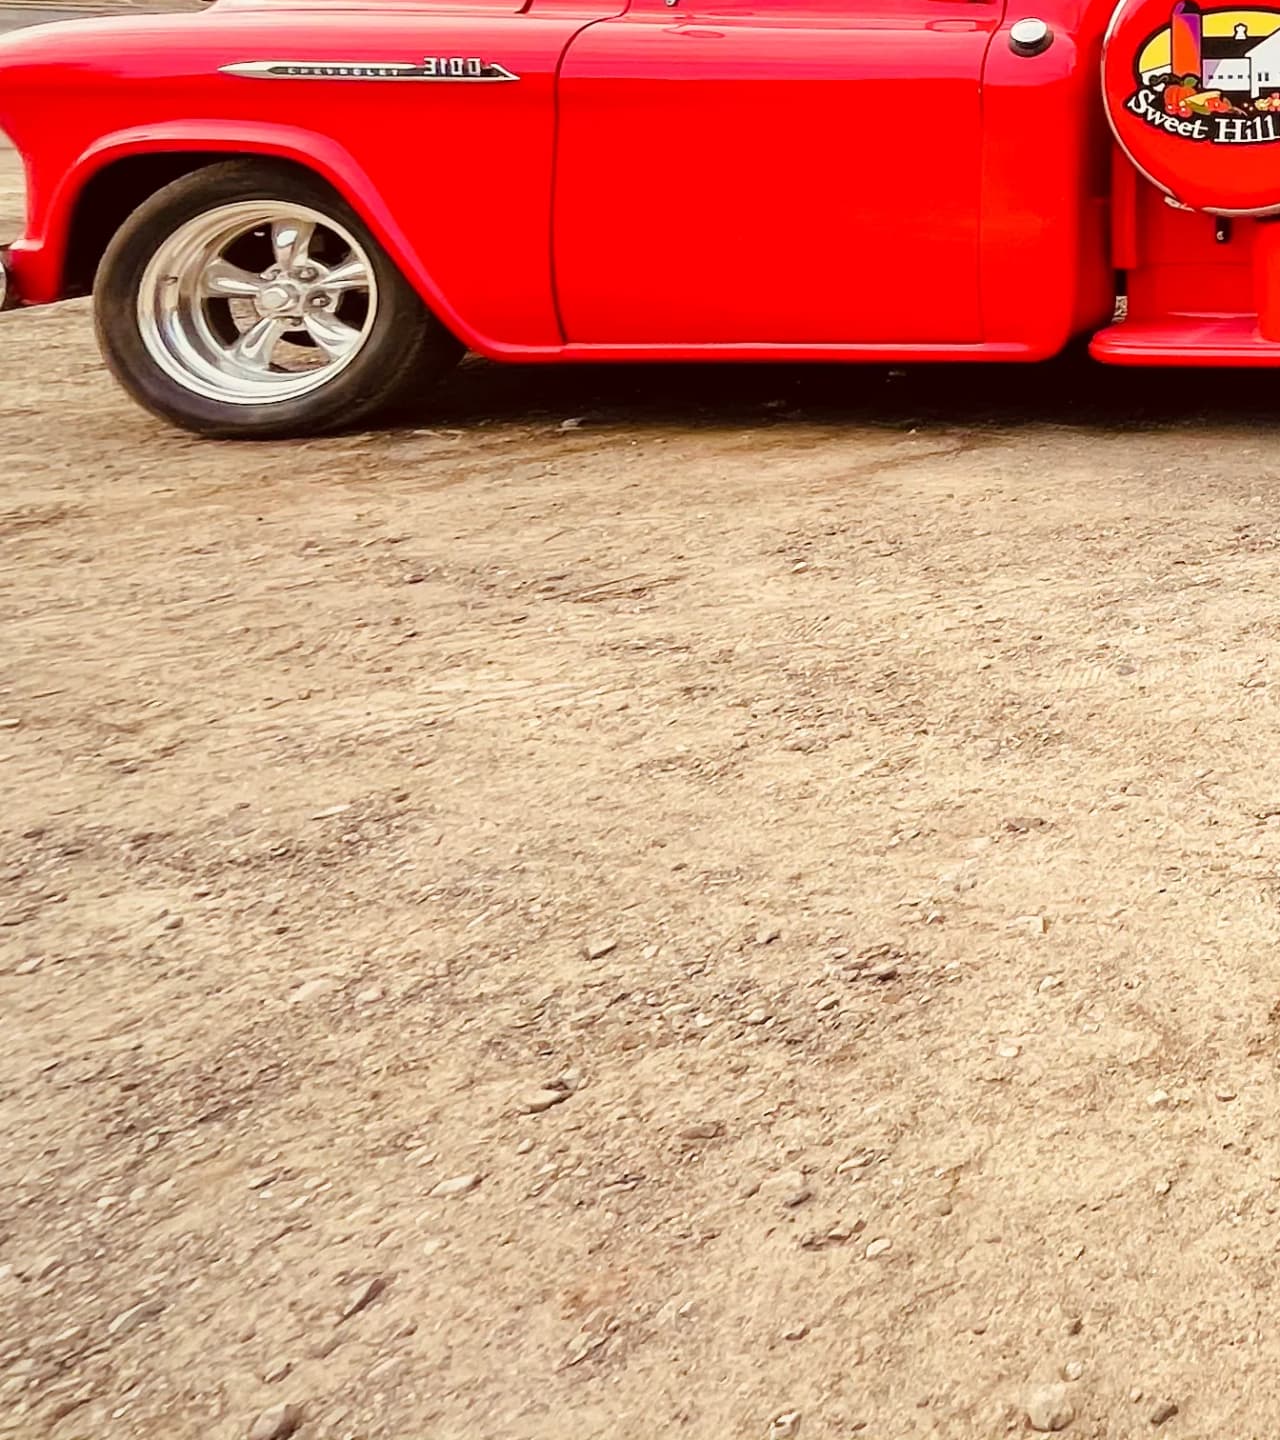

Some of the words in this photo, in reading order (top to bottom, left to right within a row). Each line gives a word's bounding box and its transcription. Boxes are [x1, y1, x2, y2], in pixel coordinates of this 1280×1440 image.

[423, 57, 481, 76] 3100
[1127, 88, 1209, 139] Sweet
[1213, 115, 1280, 143] Hill
